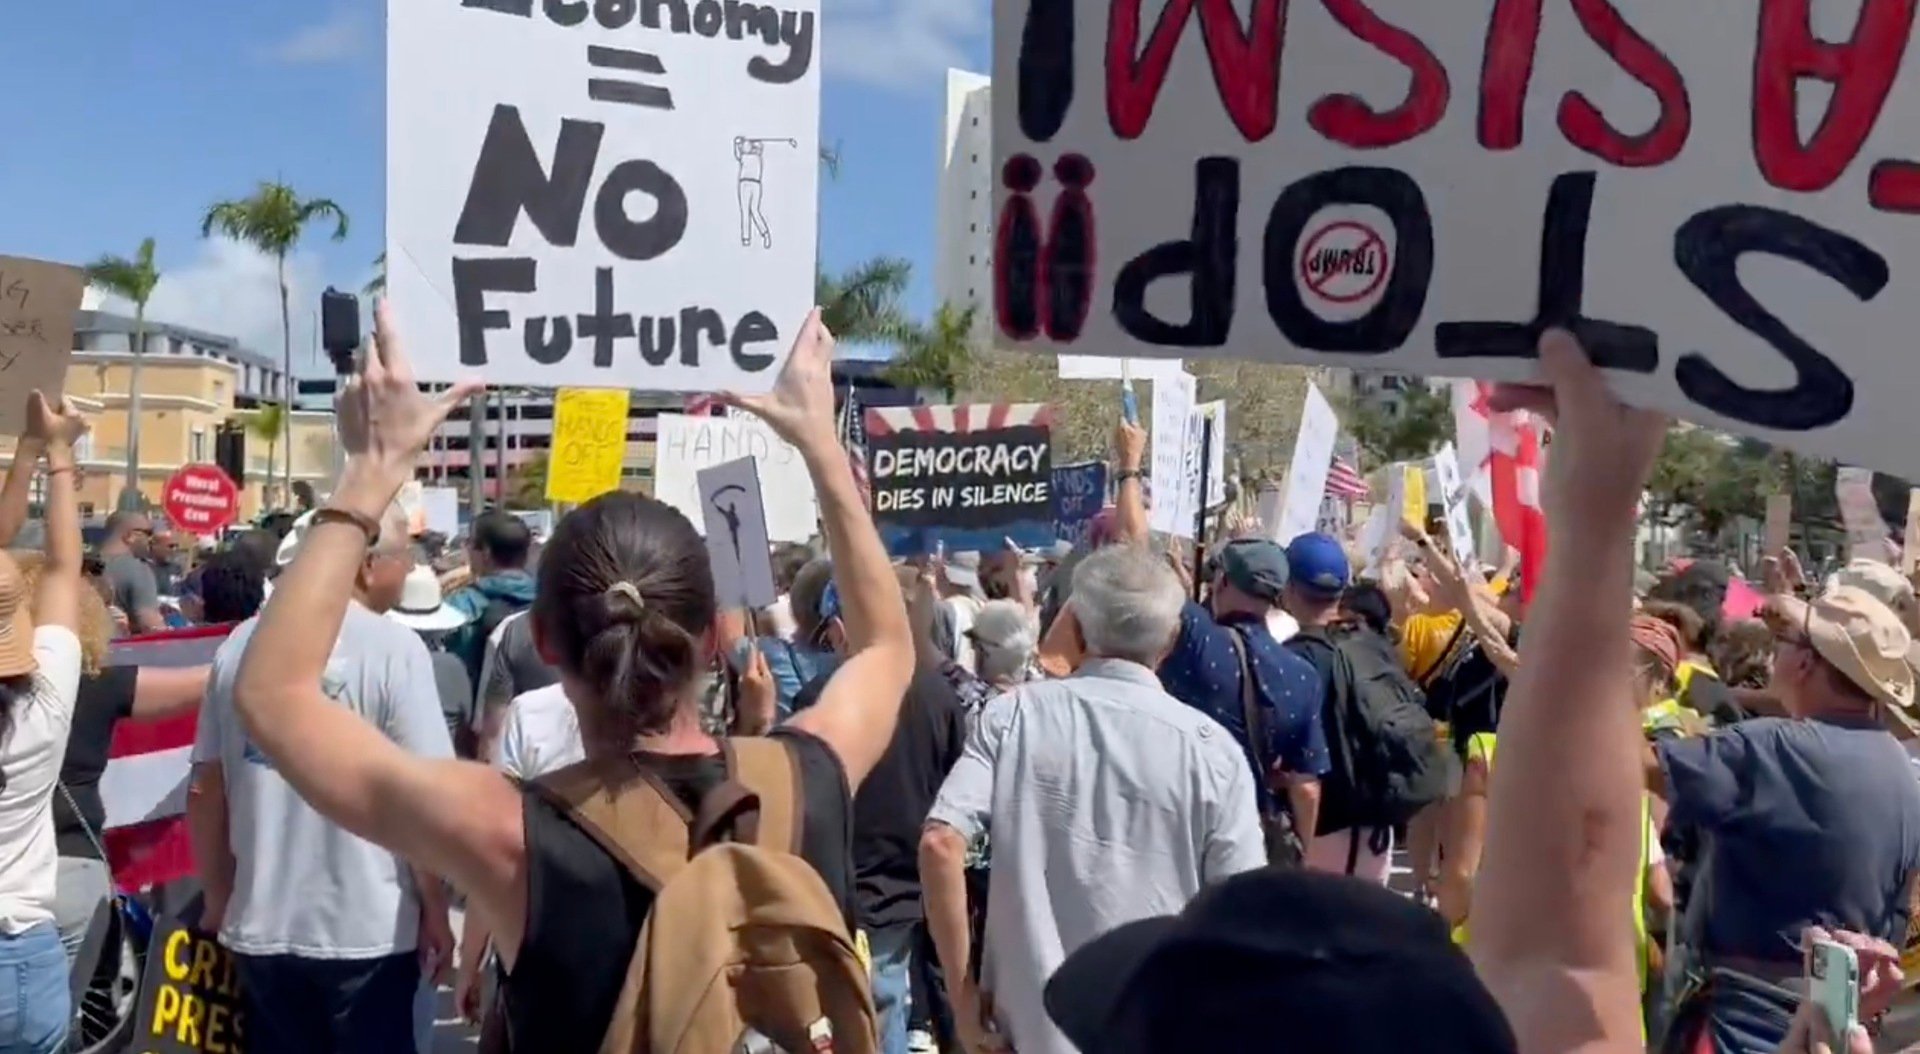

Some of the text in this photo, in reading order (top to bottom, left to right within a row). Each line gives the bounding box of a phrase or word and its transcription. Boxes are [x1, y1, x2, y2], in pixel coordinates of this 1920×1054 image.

[1307, 246, 1376, 276] TRUMP
[452, 256, 780, 373] Future
[667, 421, 797, 466] HANDS
[873, 443, 1049, 479] DEMOCRACY
[876, 481, 1049, 512] DIES IN SILENCE
